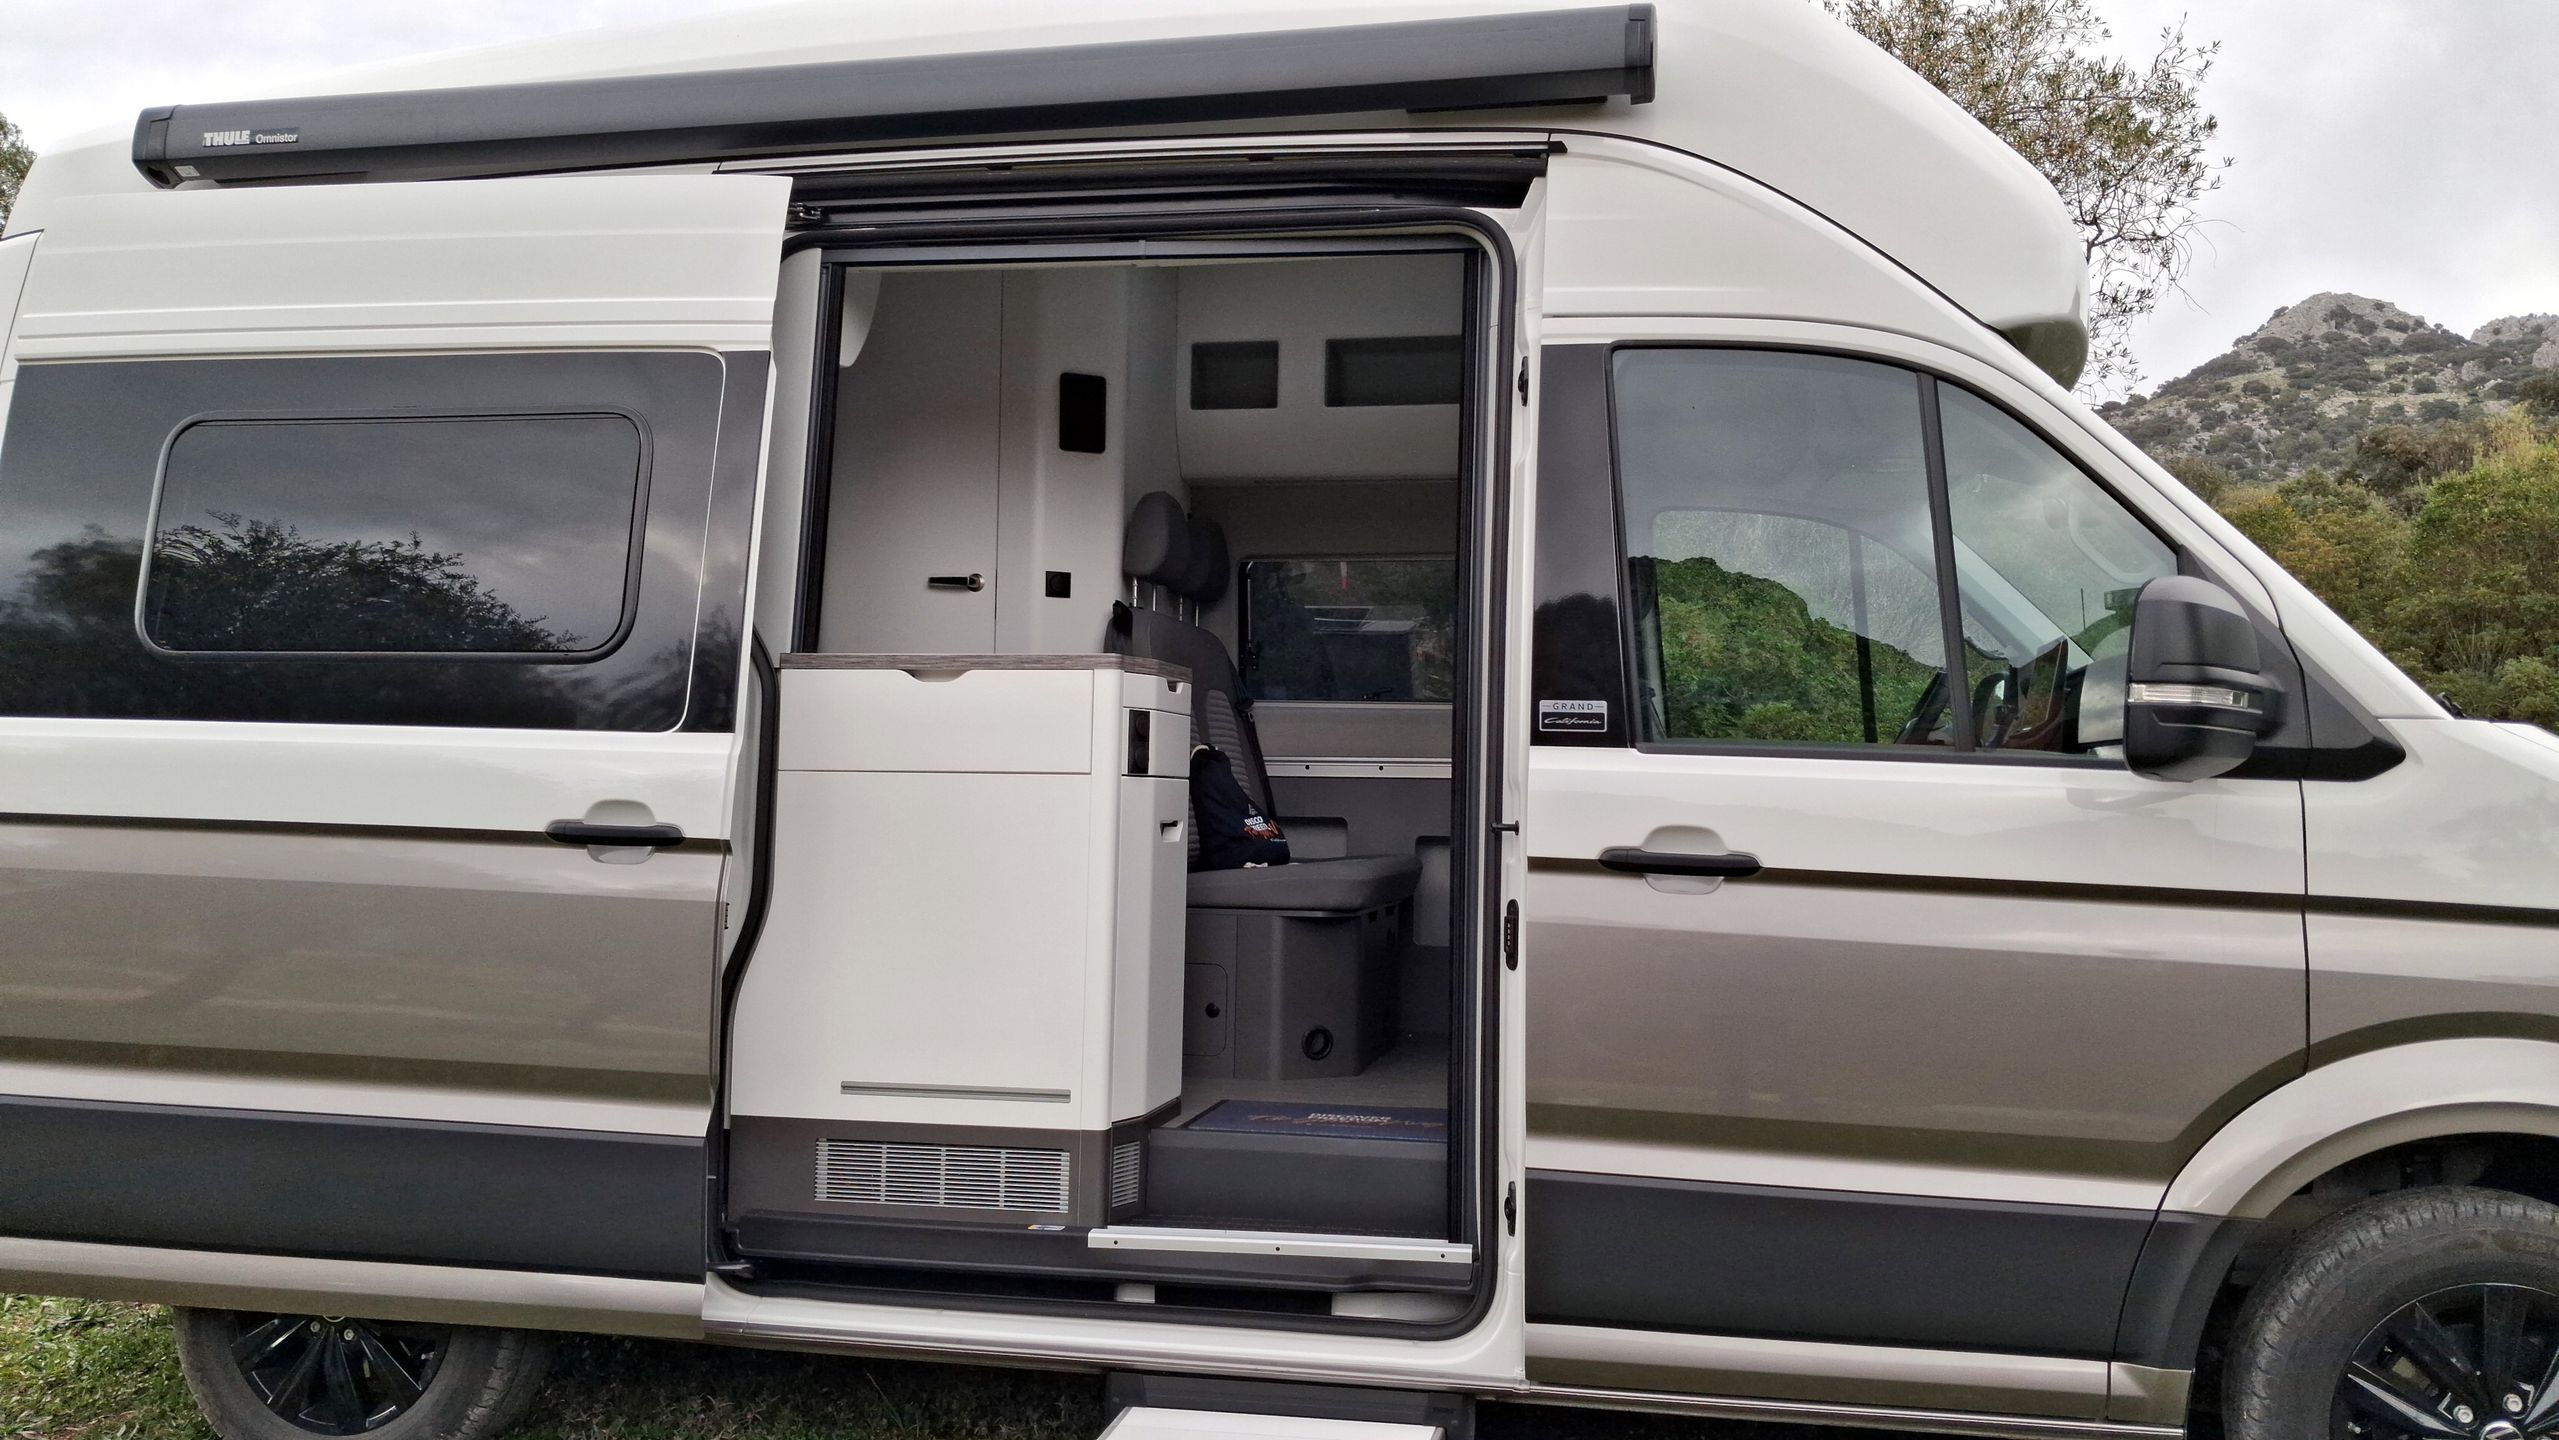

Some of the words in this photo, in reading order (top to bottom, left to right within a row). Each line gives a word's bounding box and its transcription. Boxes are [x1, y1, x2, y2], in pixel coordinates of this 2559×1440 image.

[203, 130, 250, 147] THULE
[255, 133, 298, 144] Omnistor
[1552, 702, 1594, 711] GRAND
[1544, 717, 1602, 725] California
